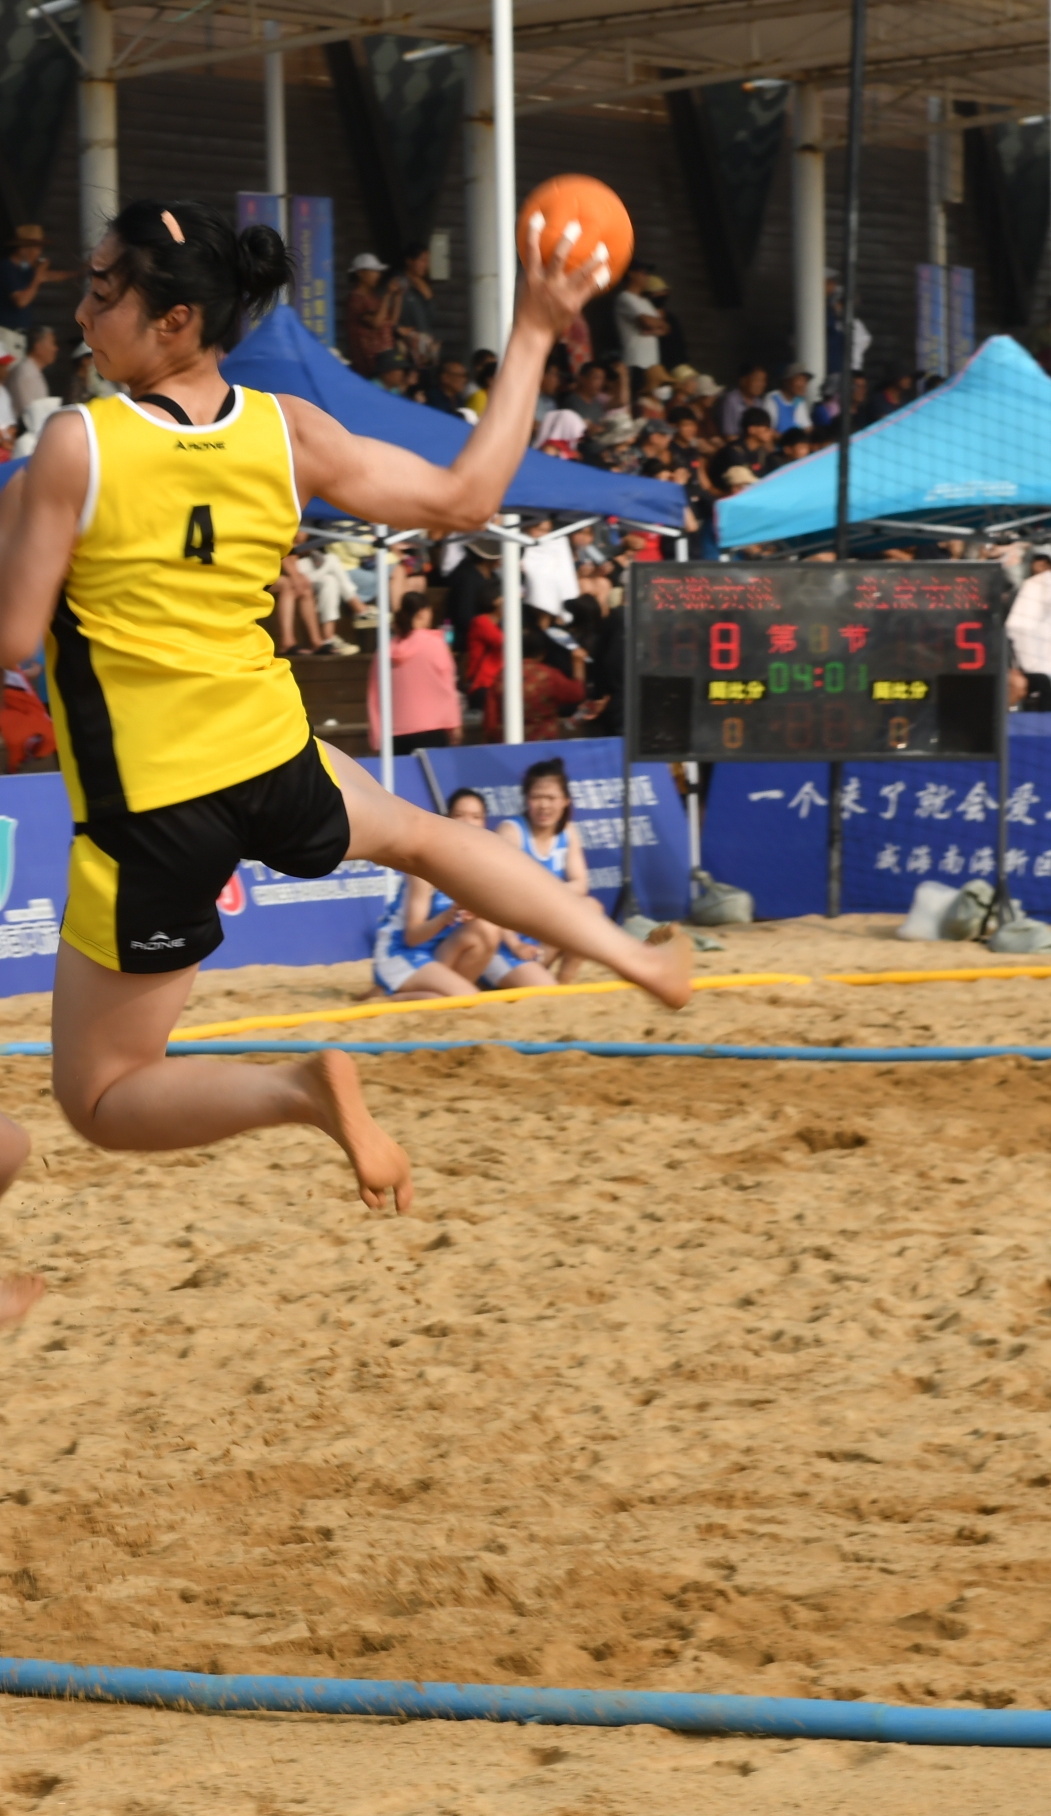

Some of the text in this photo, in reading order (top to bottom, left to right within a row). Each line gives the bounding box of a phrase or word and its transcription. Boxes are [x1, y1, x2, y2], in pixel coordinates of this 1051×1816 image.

[184, 504, 215, 565] 4
[709, 621, 741, 671] 8
[954, 621, 986, 671] 5
[768, 660, 869, 694] 04:01
[749, 777, 1051, 826] 一个来了就会爱
